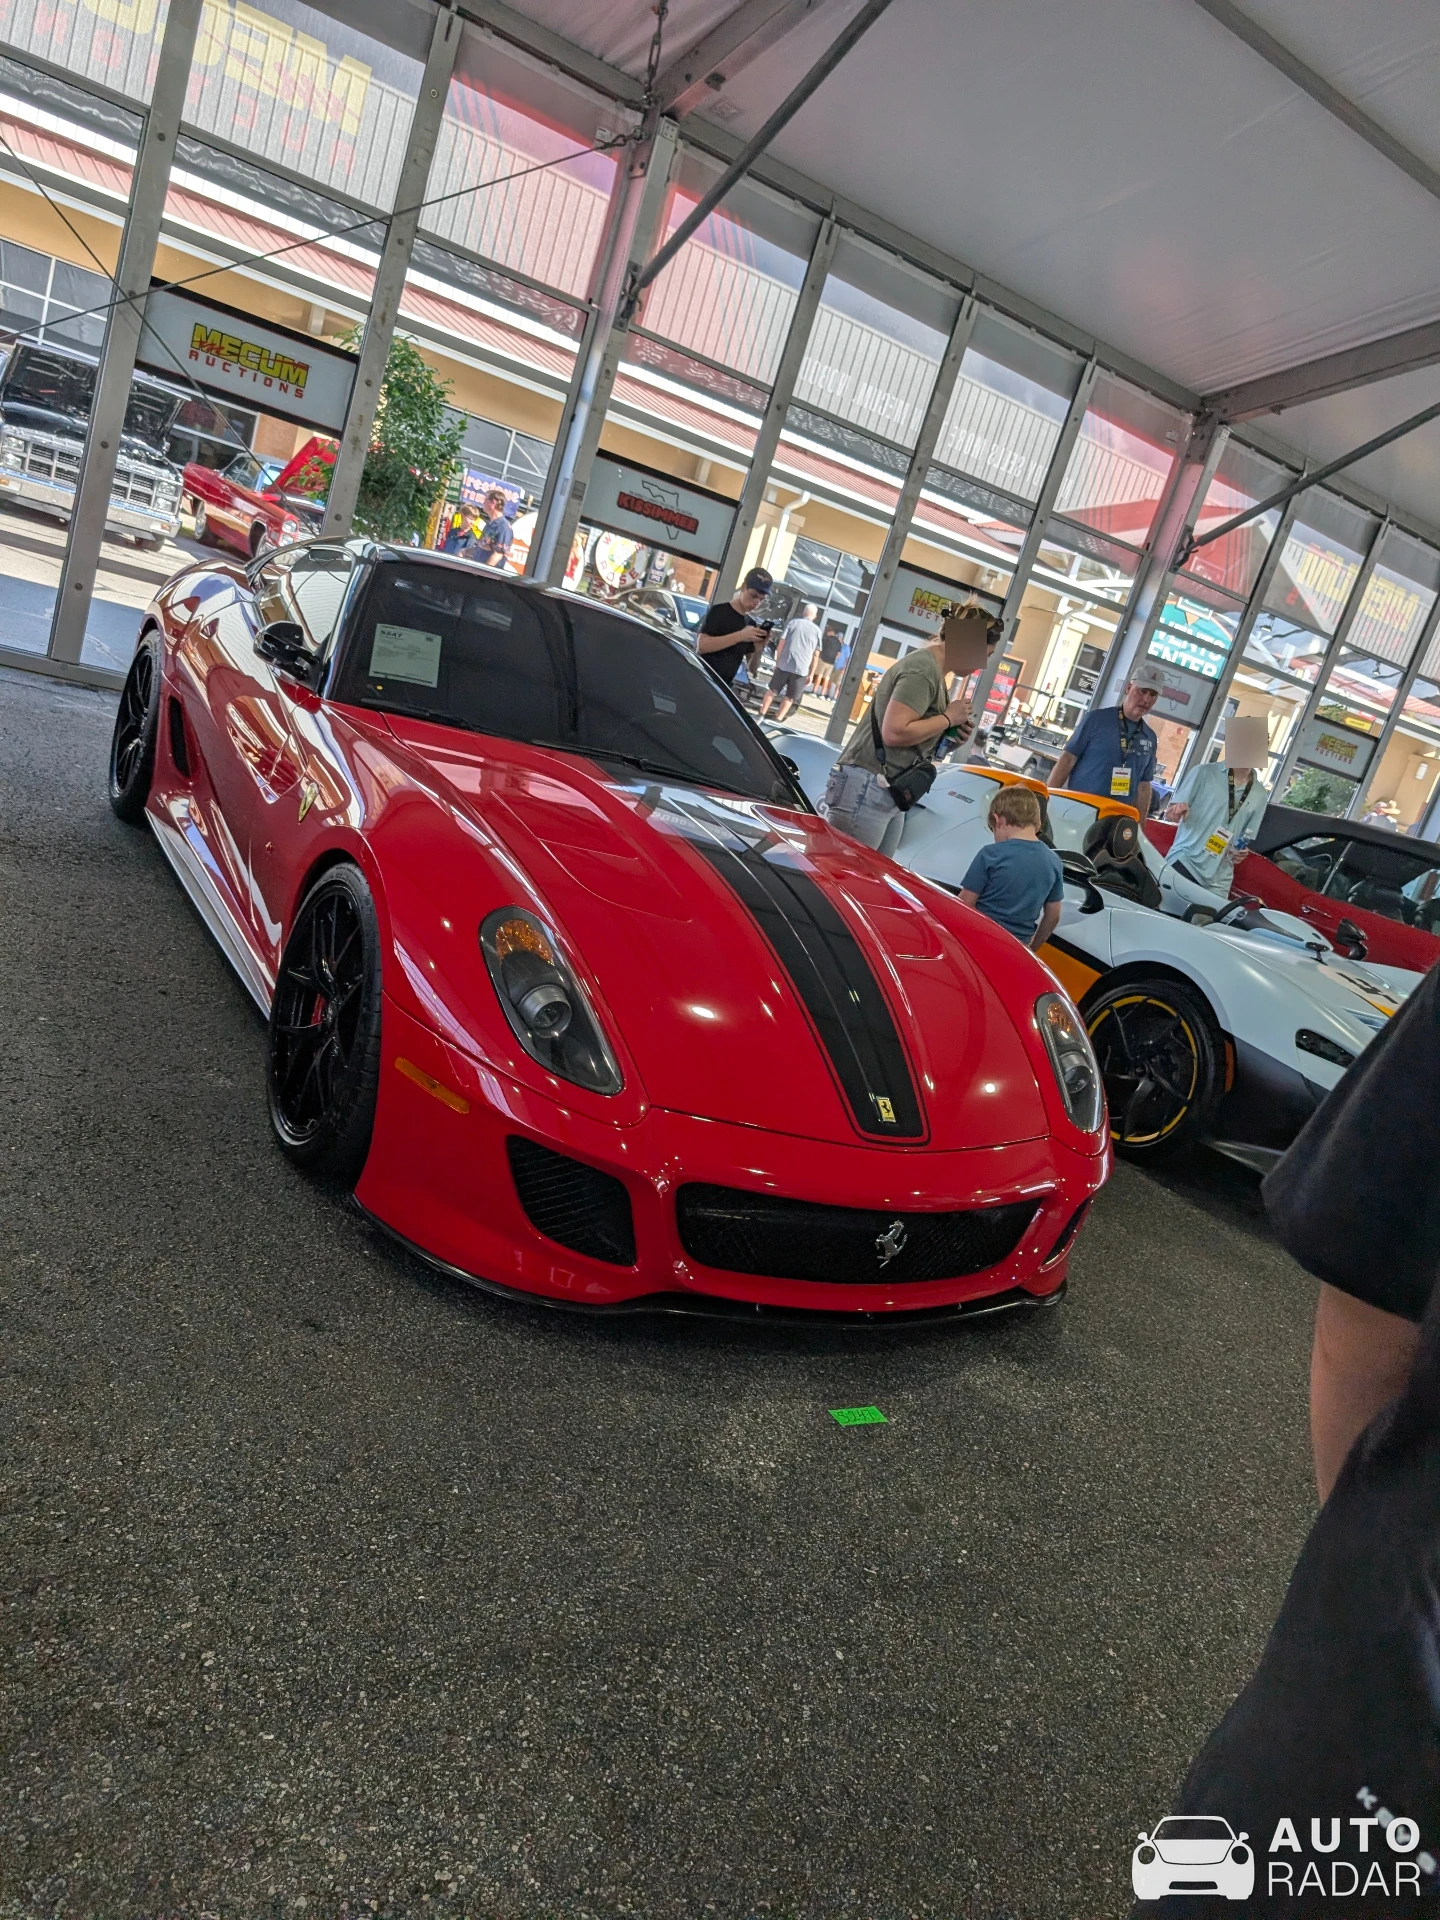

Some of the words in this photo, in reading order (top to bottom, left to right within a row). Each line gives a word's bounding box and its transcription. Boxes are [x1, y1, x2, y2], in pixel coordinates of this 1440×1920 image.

[188, 349, 305, 399] AUCTIONS
[190, 323, 309, 389] MECUM
[617, 491, 699, 535] KISSIMMEE
[911, 587, 955, 617] MEC
[1147, 641, 1217, 679] ENTER
[1317, 733, 1359, 760] MECUM
[1208, 838, 1225, 850] GUEST
